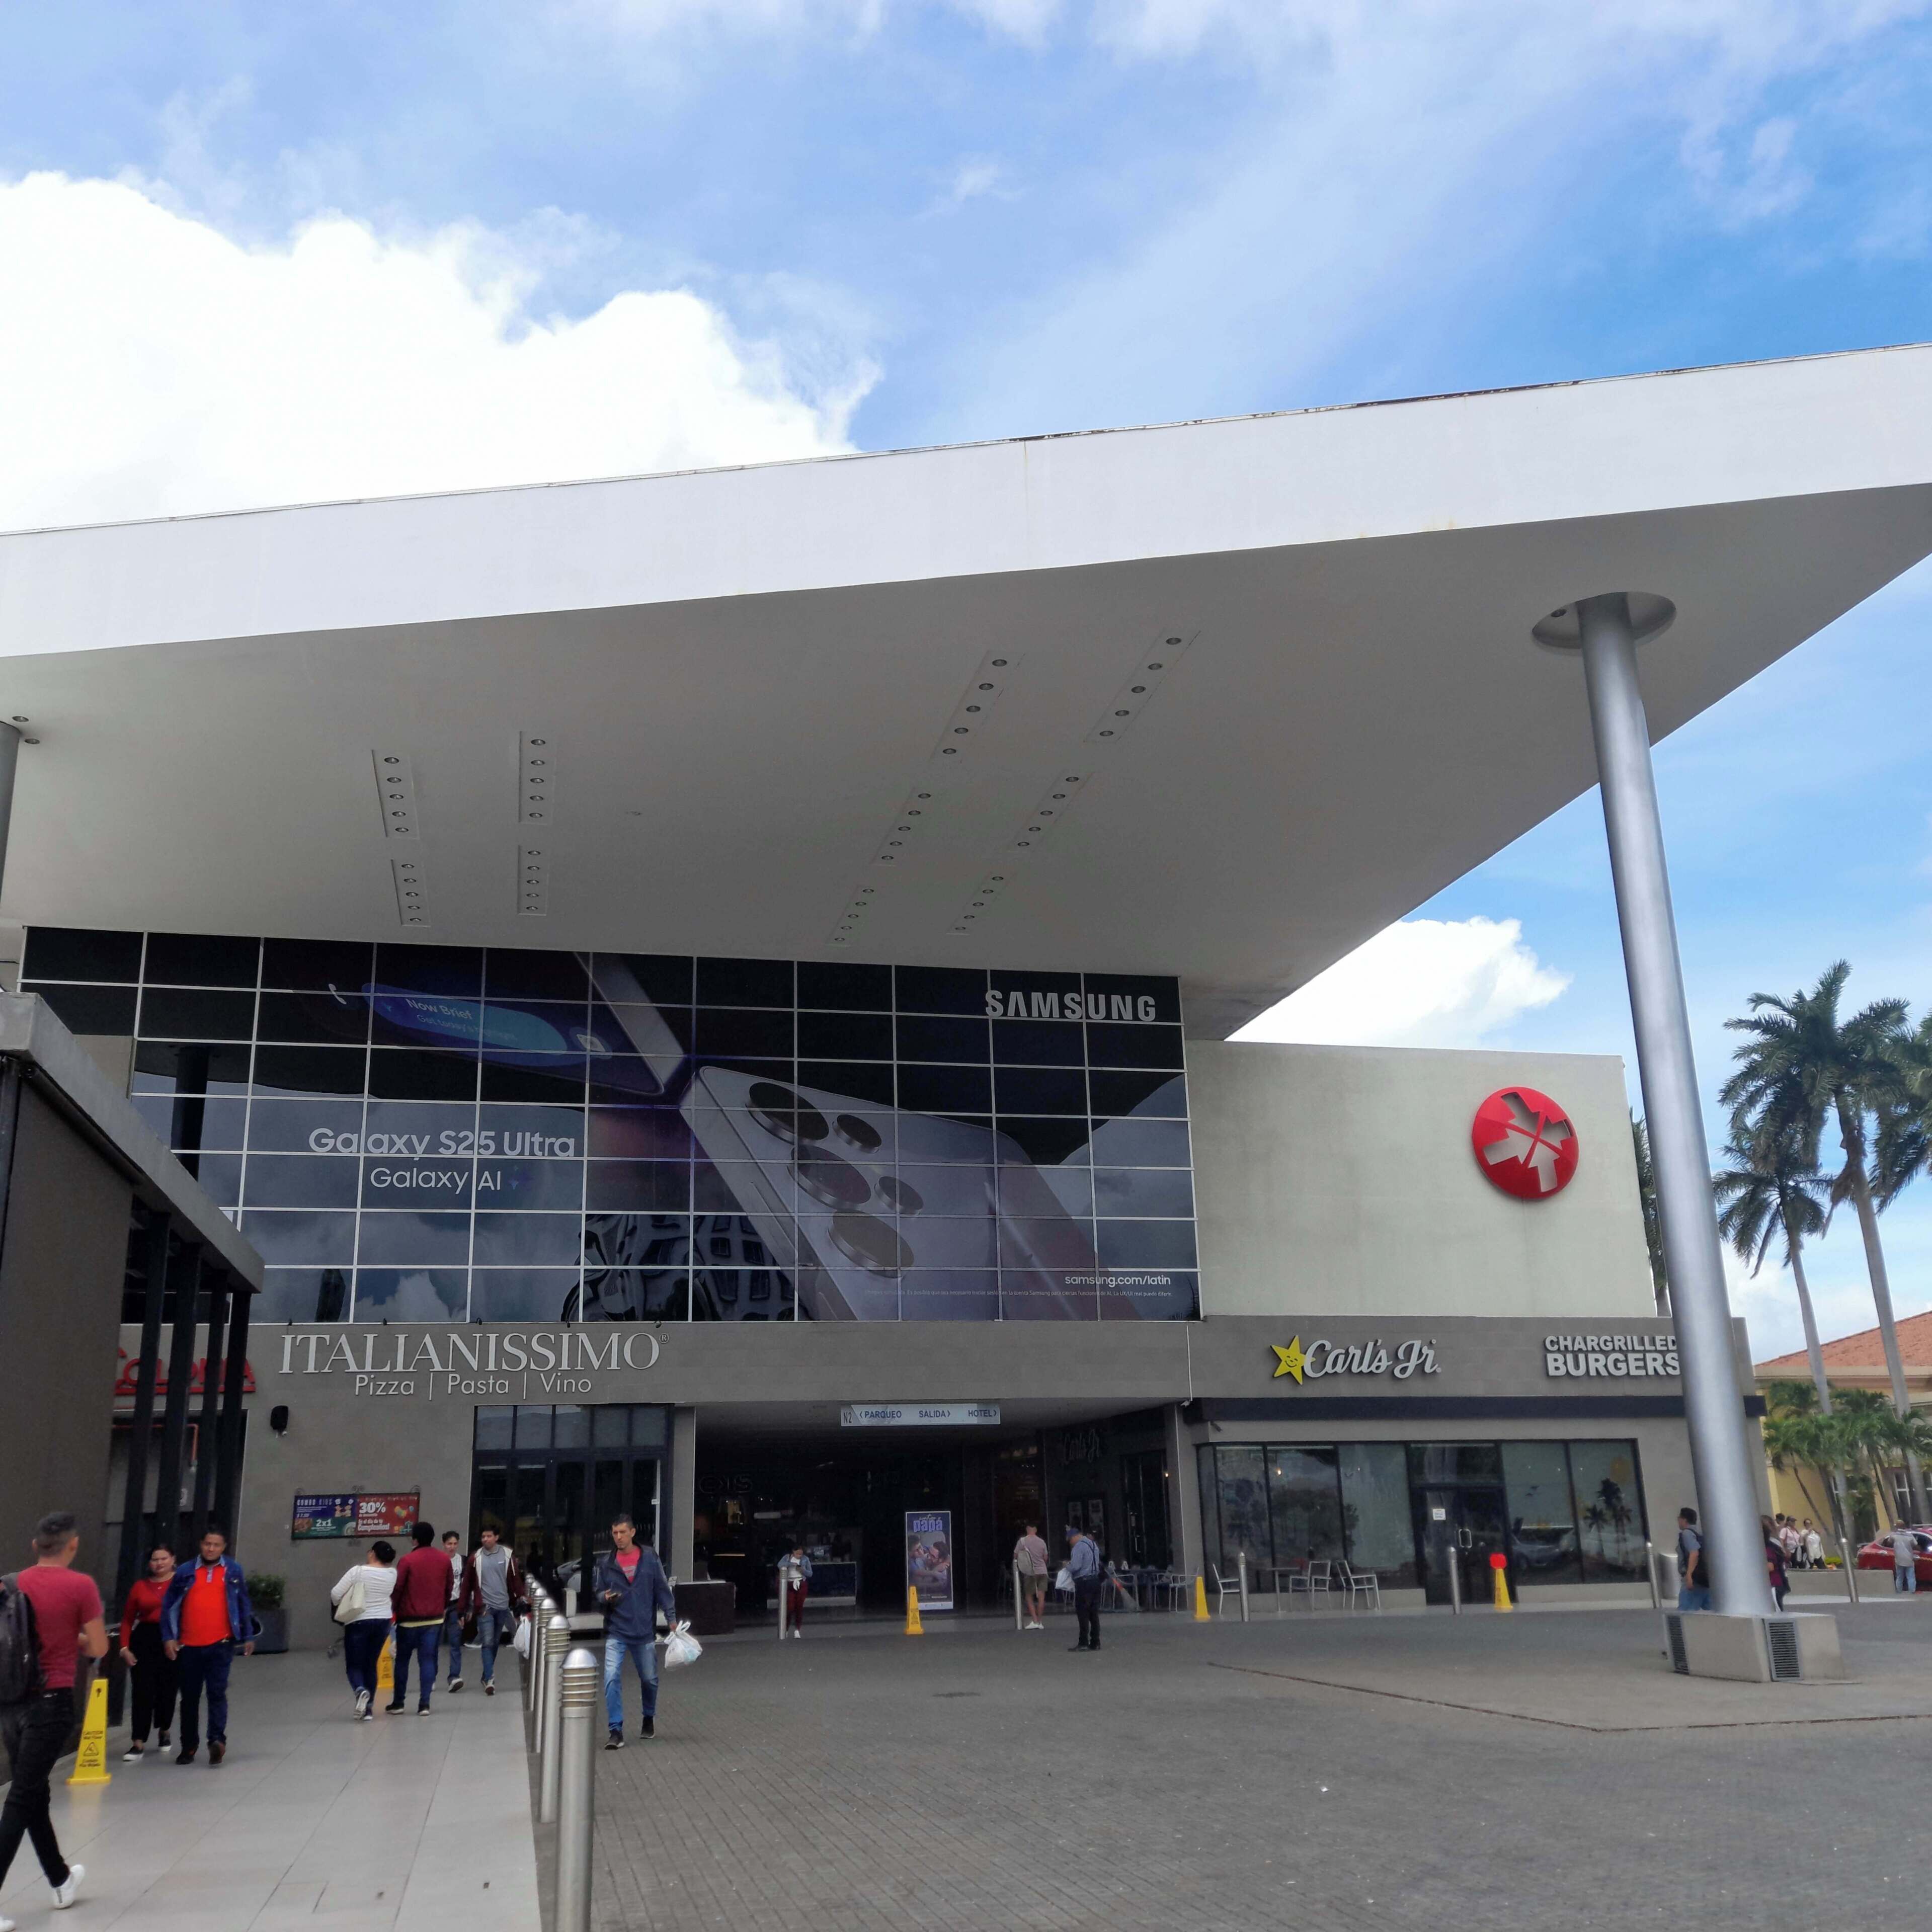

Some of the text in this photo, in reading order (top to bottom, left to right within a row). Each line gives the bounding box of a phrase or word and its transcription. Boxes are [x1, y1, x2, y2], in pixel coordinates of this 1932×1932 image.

[405, 998, 473, 1020] Now Brief
[985, 990, 1156, 1022] SAMSUNG
[308, 1127, 575, 1161] Galaxy S25 Ultra
[370, 1167, 501, 1194] Galaxy AI
[1065, 1274, 1171, 1287] samsung.com/latin
[1545, 1335, 1678, 1351] CHARGRILLED
[1303, 1339, 1393, 1378] Carl's
[1546, 1352, 1681, 1377] BURGERS
[355, 1372, 592, 1396] Pizza Pasta Vino
[843, 1411, 853, 1424] N2
[864, 1409, 992, 1418] PARQUEO SALIDA HOTEL
[359, 1501, 386, 1513] 30%
[316, 1518, 332, 1527] 2x1
[913, 1517, 943, 1533] papá
